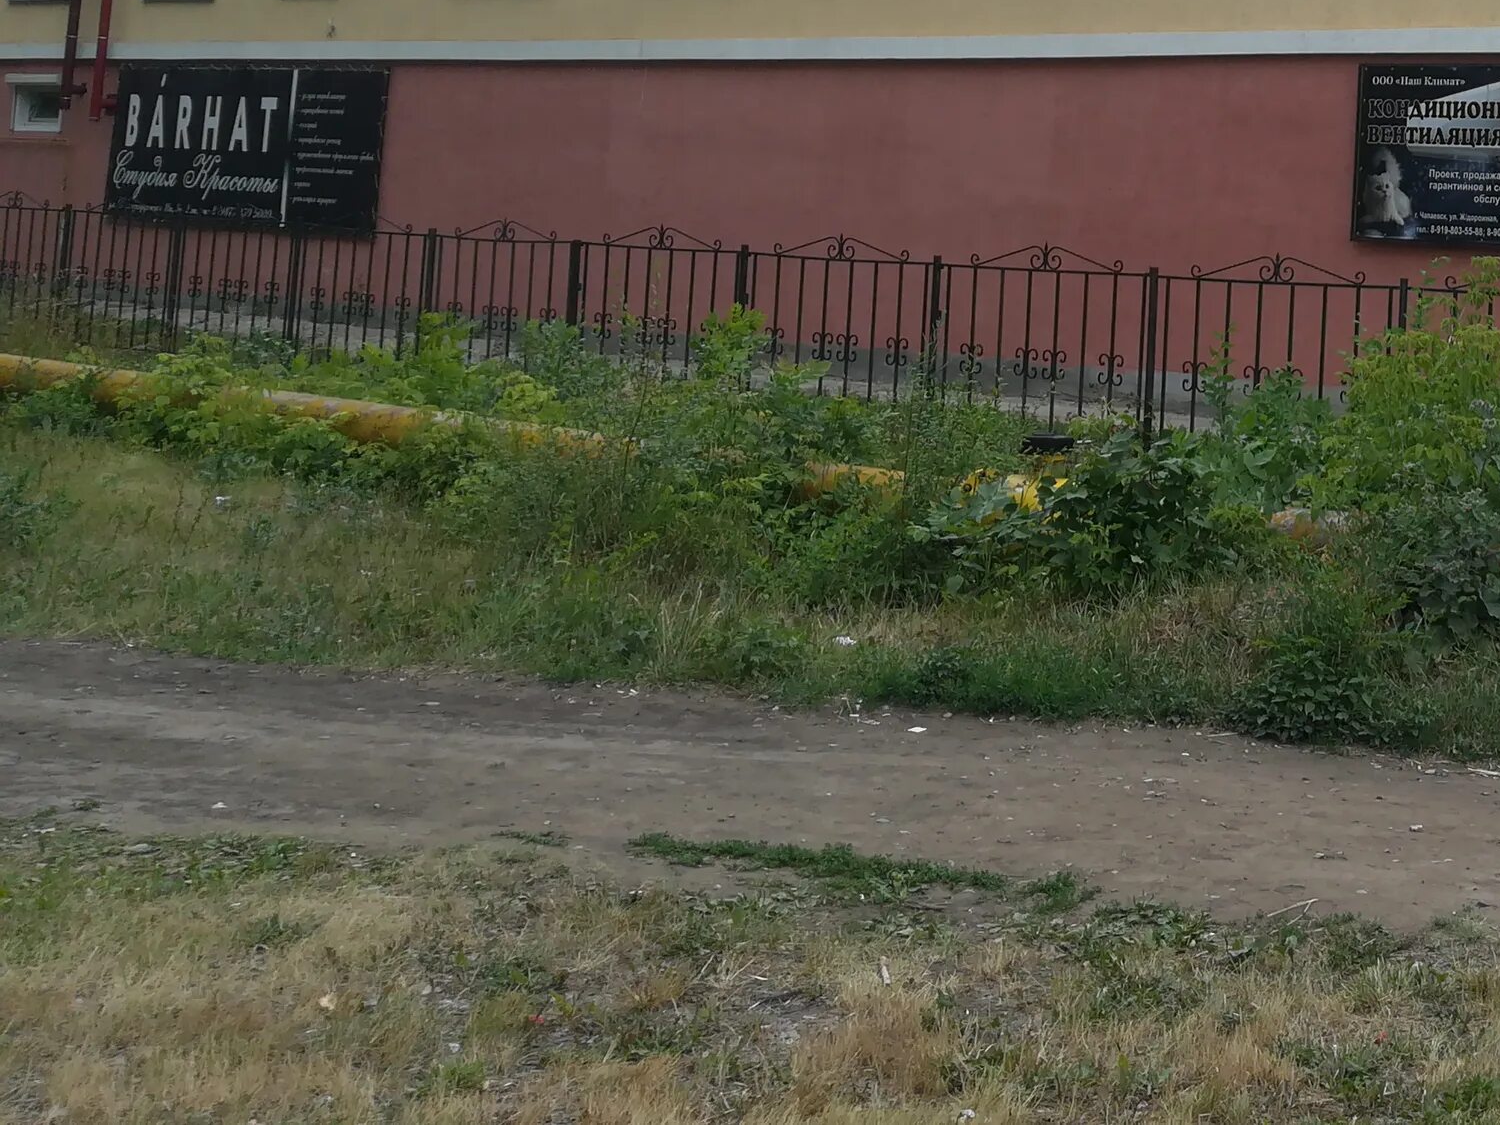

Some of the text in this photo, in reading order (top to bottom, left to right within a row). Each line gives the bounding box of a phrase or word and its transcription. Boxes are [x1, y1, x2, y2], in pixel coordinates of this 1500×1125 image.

[1372, 76, 1393, 86] ООО
[1424, 76, 1466, 87] Климат»
[113, 149, 279, 200] Студия Красоты
[1428, 169, 1461, 180] Проект,
[1429, 182, 1484, 193] гарантийное
[1486, 184, 1492, 192] и
